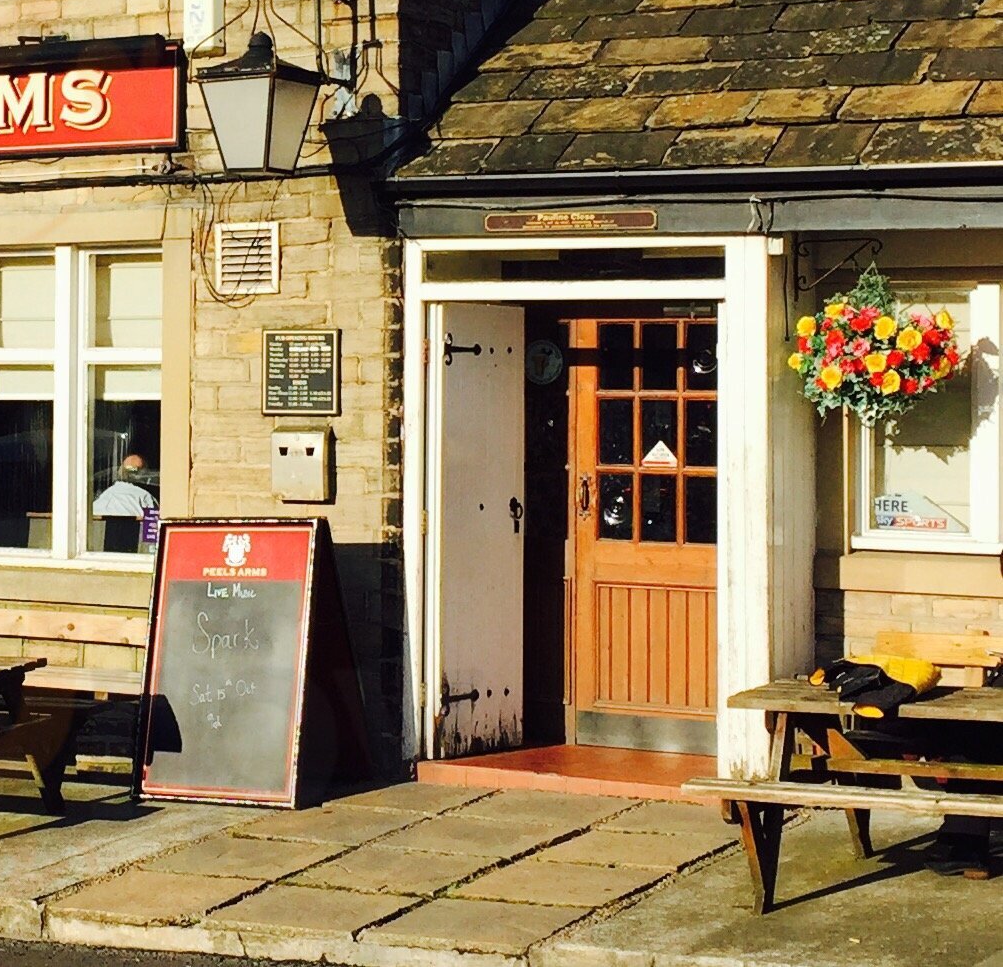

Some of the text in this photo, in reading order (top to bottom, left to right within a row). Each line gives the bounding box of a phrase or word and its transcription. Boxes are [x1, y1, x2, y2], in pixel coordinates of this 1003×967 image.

[571, 212, 596, 221] Close
[874, 499, 908, 513] HERE
[203, 566, 267, 577] PEELS ARMS
[192, 611, 259, 659] Spark
[190, 683, 212, 706] Sat
